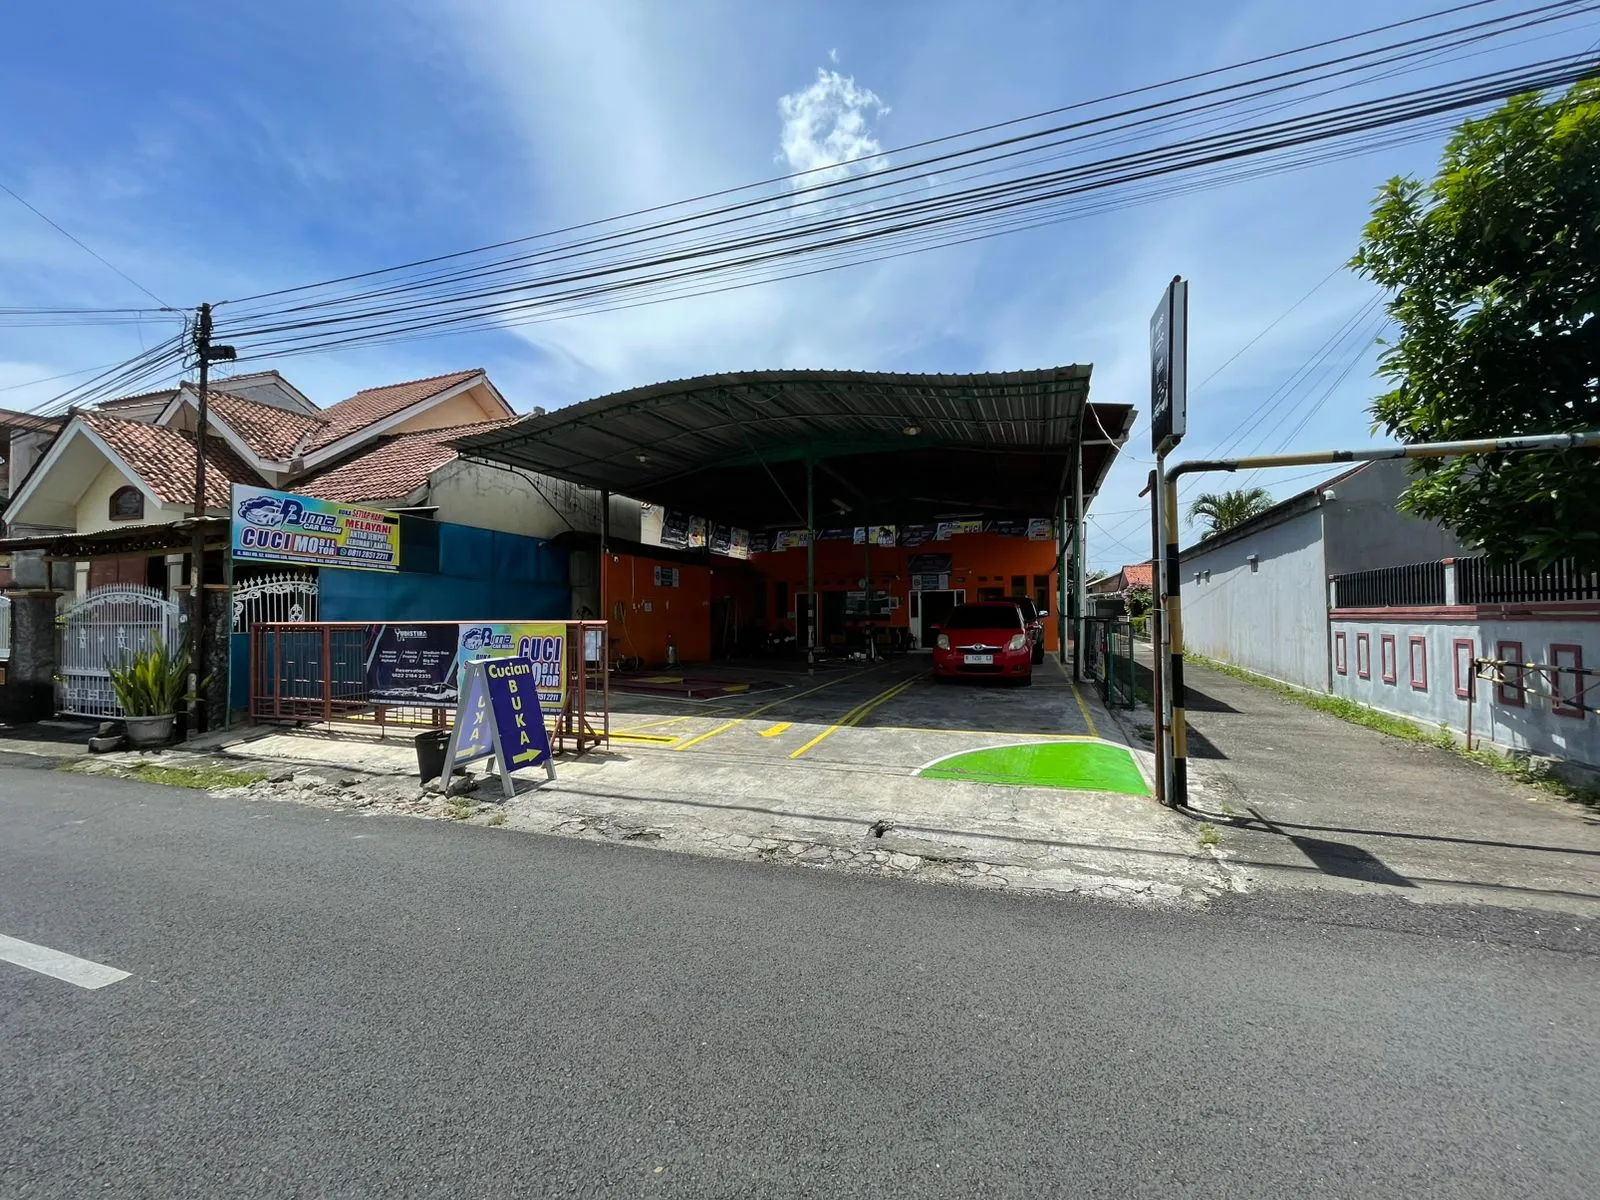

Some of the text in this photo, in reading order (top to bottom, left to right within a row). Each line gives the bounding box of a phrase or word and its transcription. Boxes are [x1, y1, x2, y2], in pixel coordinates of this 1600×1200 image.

[279, 498, 337, 529] Bima
[303, 523, 342, 534] CAR WASH
[345, 518, 392, 534] MELAYANI
[241, 527, 319, 554] CUCI MO
[319, 538, 337, 548] BIL
[319, 546, 336, 556] TOR
[347, 548, 361, 557] 0811
[375, 552, 389, 560] 2211
[481, 628, 513, 647] Bima
[518, 636, 562, 662] CUCI
[488, 662, 530, 679] Cucian
[542, 662, 560, 674] BIL
[541, 674, 560, 686] TOR
[508, 679, 531, 746] BUKA
